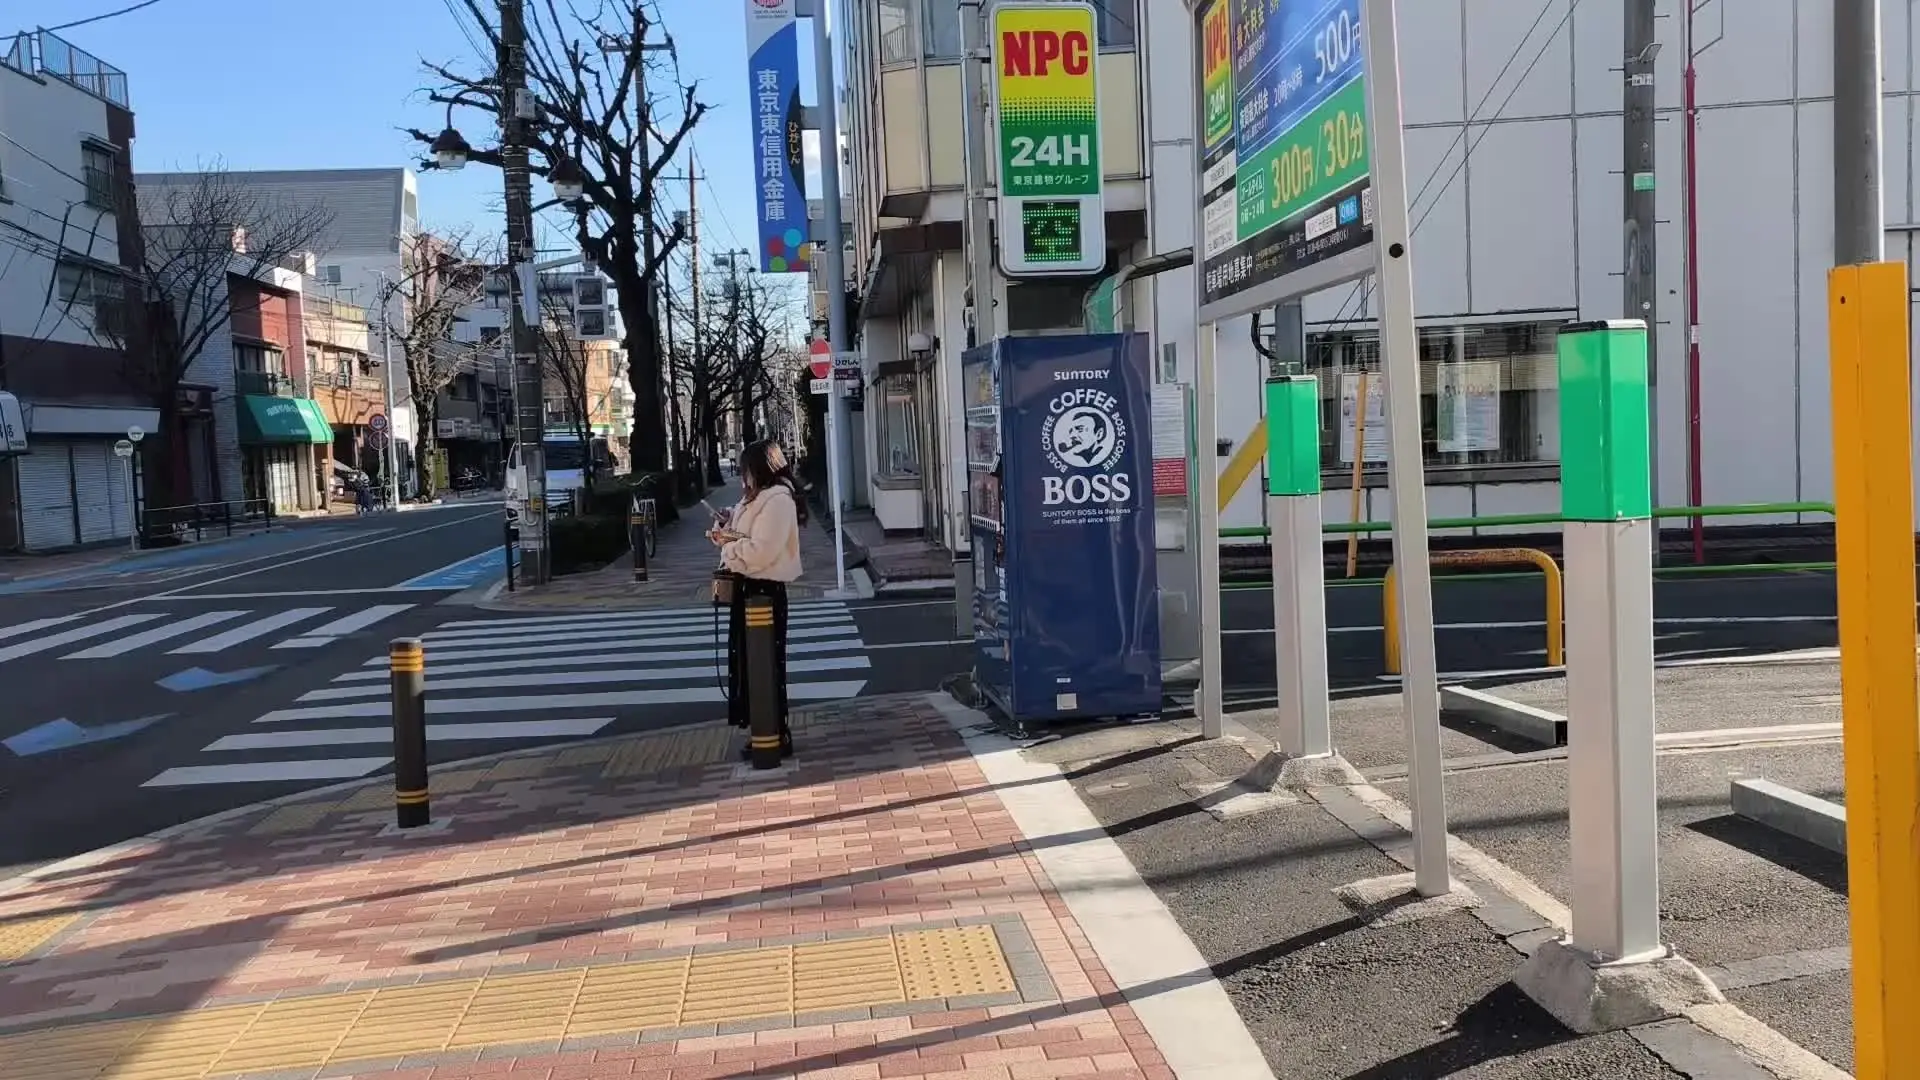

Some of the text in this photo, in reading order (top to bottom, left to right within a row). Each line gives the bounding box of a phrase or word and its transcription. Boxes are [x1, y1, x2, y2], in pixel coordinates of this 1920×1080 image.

[1003, 31, 1088, 76] NPC
[1315, 10, 1361, 83] 500円
[1210, 82, 1225, 121] 24H
[757, 69, 786, 222] 東京東信用金庫
[788, 121, 800, 165] ひがしん
[1010, 134, 1089, 167] 24H
[1013, 174, 1089, 186] 東京建物グループ
[1050, 388, 1117, 414] COFFEE
[1041, 415, 1068, 473] BOSS COFFEE
[1102, 411, 1126, 472] BOSS COFFEE
[1041, 472, 1131, 505] BOSS
[1042, 509, 1076, 518] SUNTORY
[1077, 508, 1097, 516] BOSS
[1098, 507, 1104, 515] is
[1104, 507, 1114, 515] the
